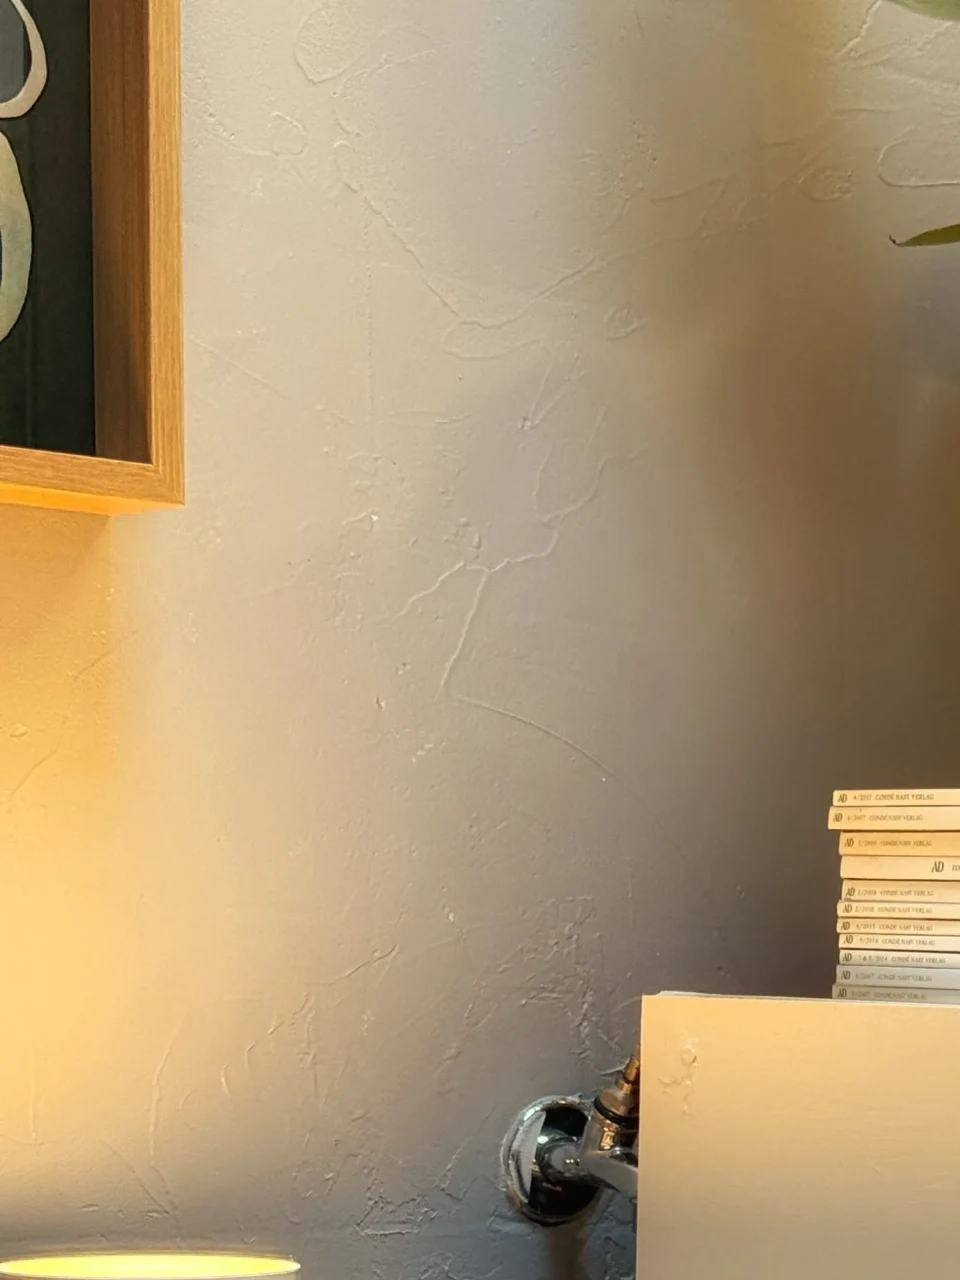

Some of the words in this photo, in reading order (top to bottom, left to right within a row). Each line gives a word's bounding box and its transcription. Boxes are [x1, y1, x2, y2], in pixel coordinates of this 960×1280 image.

[838, 793, 848, 803] AD
[833, 813, 843, 822] AD
[844, 838, 855, 848] AD
[931, 860, 944, 873] AD
[846, 887, 855, 897] AD
[843, 904, 852, 913] AD
[841, 921, 850, 931] AD
[843, 934, 854, 944] AD
[842, 953, 852, 962] AD
[841, 970, 851, 980] AD
[837, 988, 847, 998] AD
